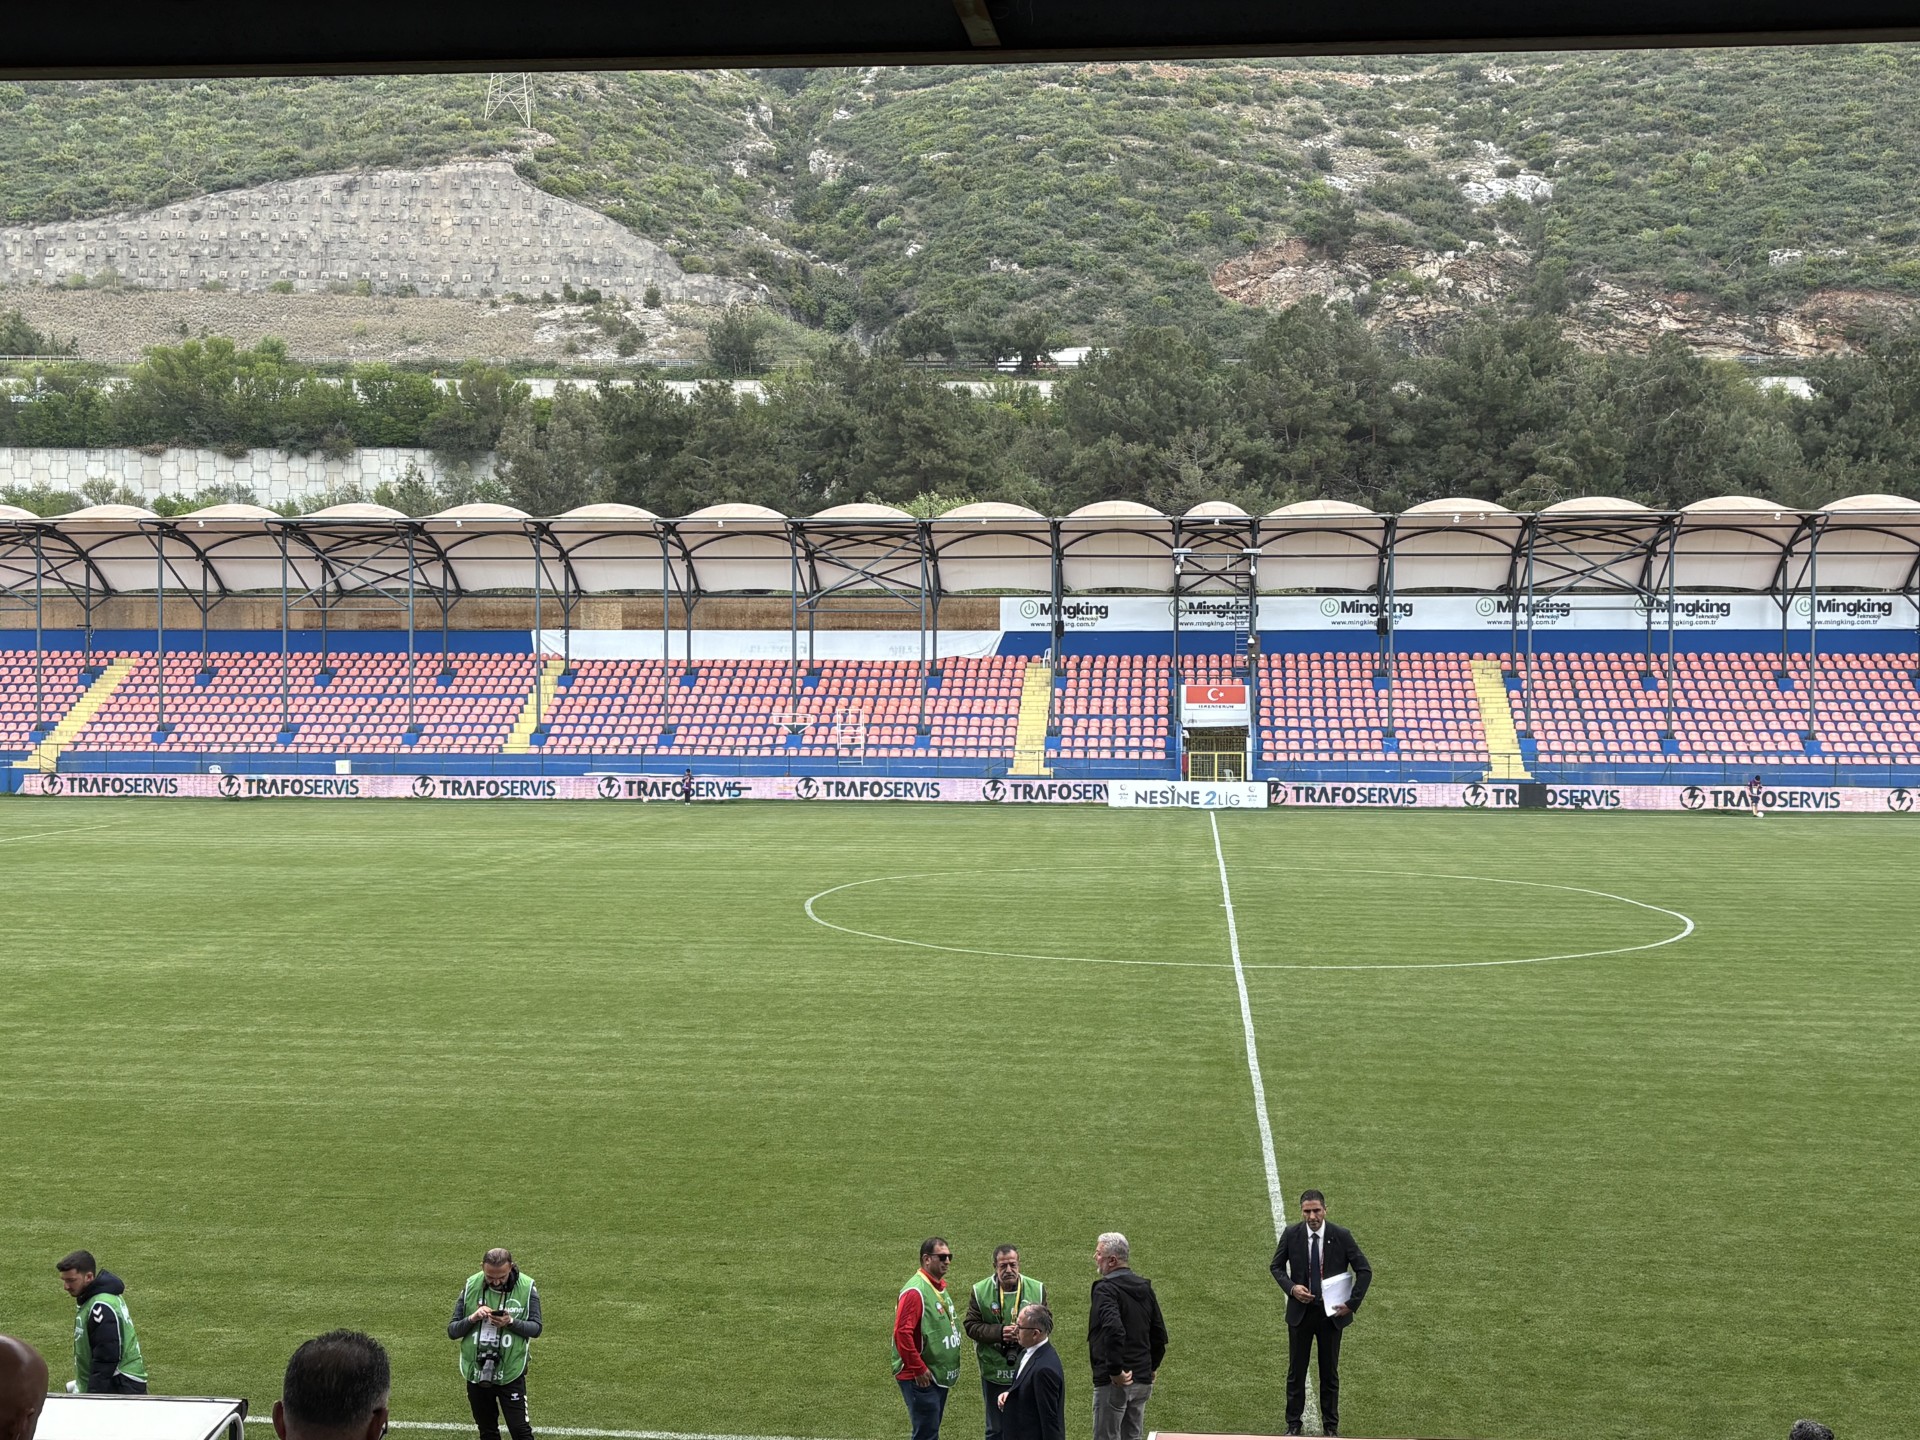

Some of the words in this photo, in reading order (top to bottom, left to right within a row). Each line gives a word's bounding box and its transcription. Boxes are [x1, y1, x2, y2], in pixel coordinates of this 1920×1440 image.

[1040, 602, 1109, 619] Mngking
[1341, 599, 1414, 617] Mingkng
[1816, 598, 1893, 617] Mingking
